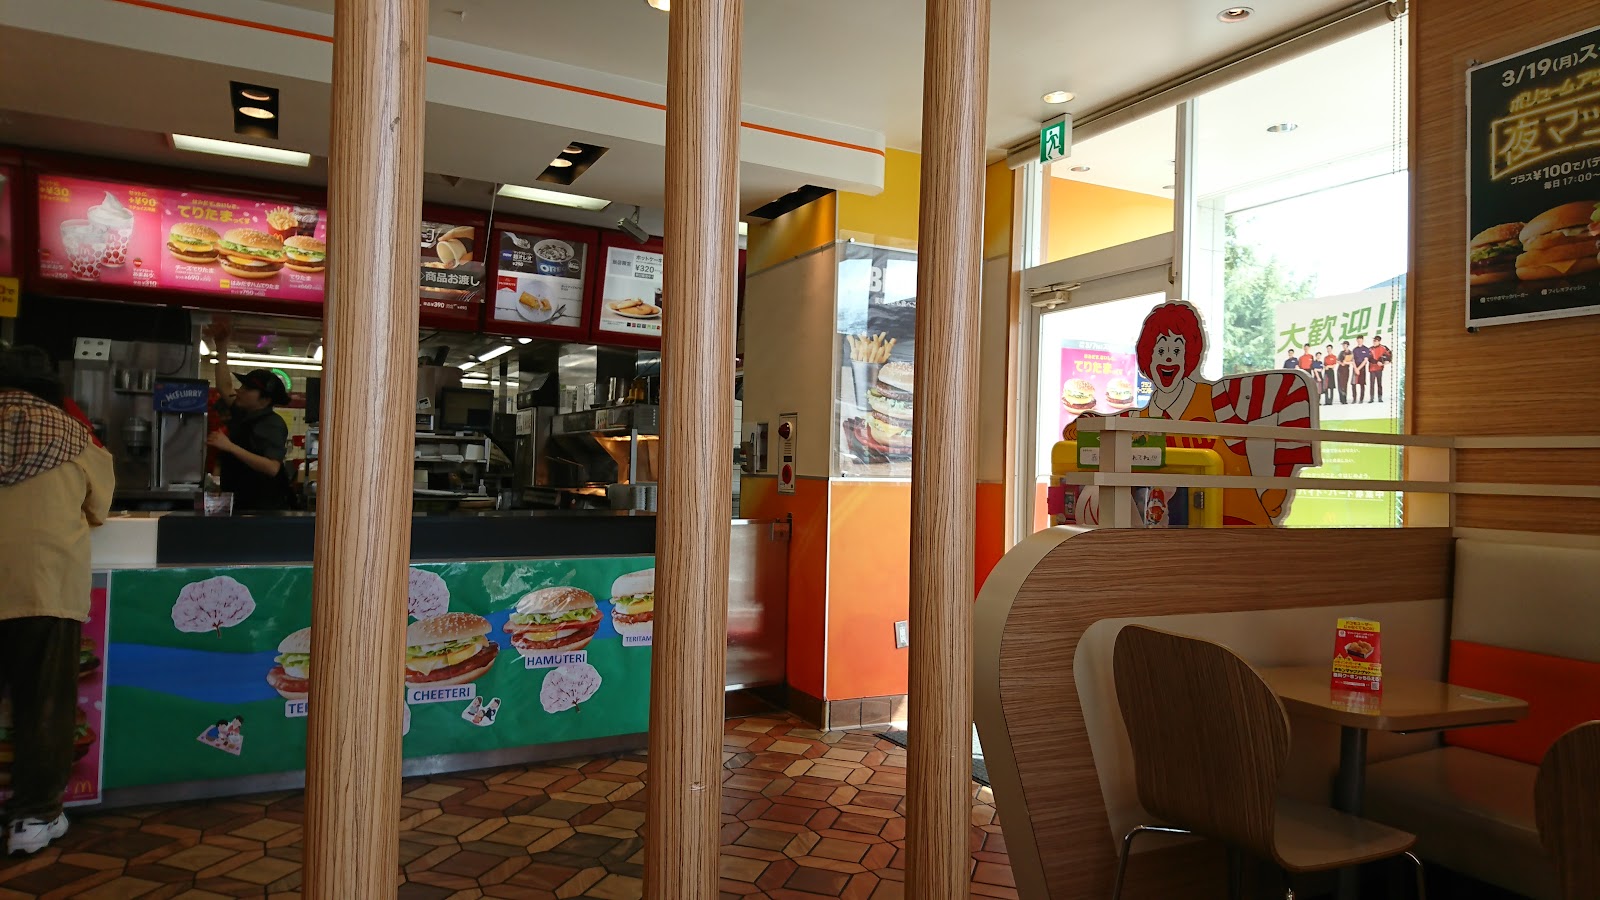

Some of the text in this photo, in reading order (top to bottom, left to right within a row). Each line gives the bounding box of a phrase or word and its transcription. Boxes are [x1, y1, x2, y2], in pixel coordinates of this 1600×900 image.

[1502, 44, 1600, 88] 3/19(月)ス
[1499, 107, 1600, 166] 夜マッ
[1544, 180, 1560, 190] 毎日
[128, 196, 157, 207] +¥90
[174, 264, 215, 274] チーズてりたま
[635, 264, 655, 273] ¥320
[289, 274, 312, 282] てりたま
[425, 271, 480, 287] 商品お渡し
[230, 280, 280, 290] はみだすハムてりたま
[526, 652, 585, 667] HAMUTERI
[413, 686, 470, 702] CHEETERI
